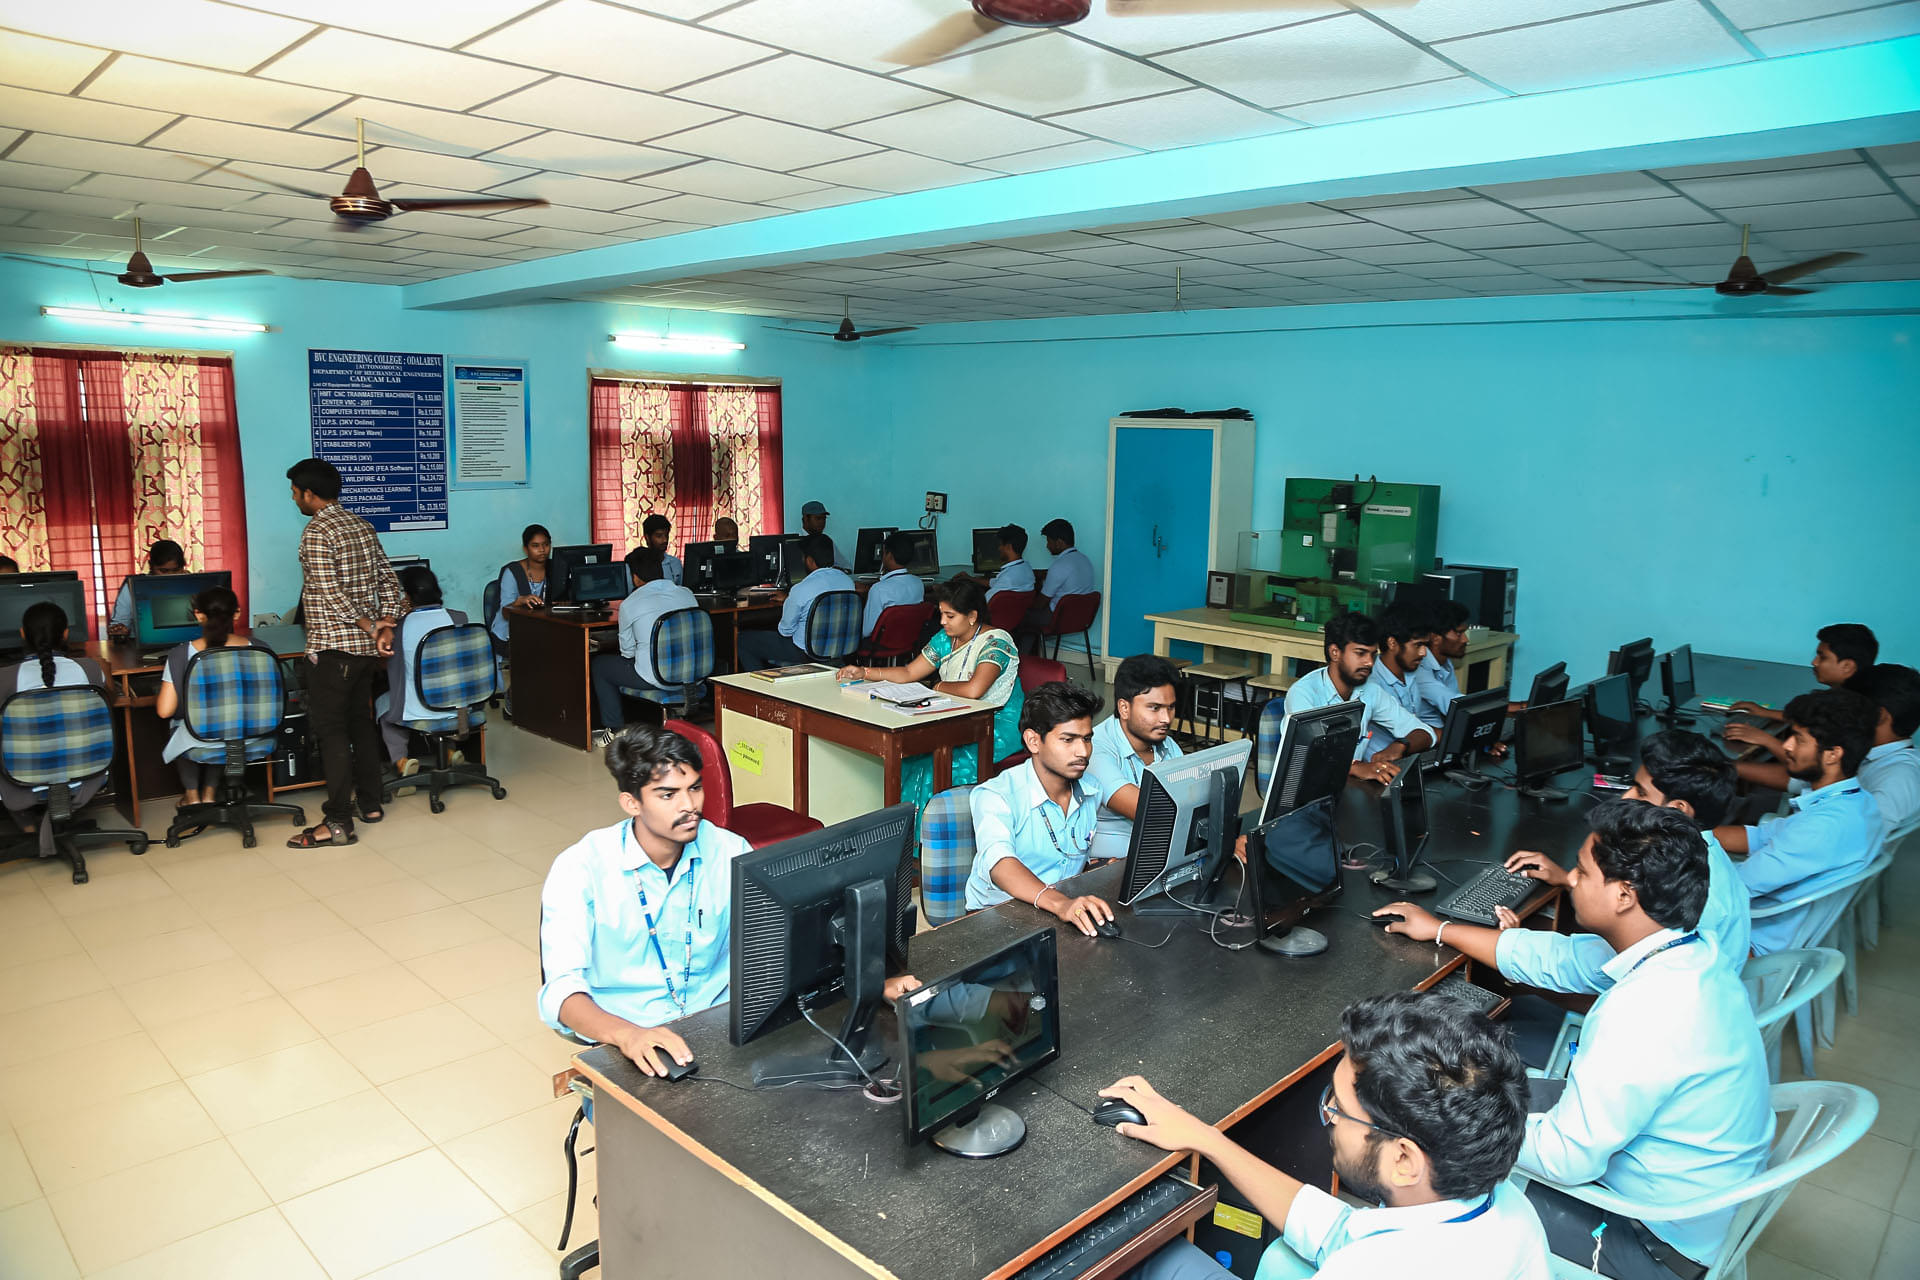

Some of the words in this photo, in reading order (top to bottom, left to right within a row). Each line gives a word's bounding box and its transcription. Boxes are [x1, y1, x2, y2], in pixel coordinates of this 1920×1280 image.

[314, 352, 327, 362] BVC
[328, 353, 372, 364] ENGINEERING
[374, 354, 402, 364] COLLEGE
[406, 356, 442, 366] ODALAREVU
[1473, 722, 1496, 737] acer
